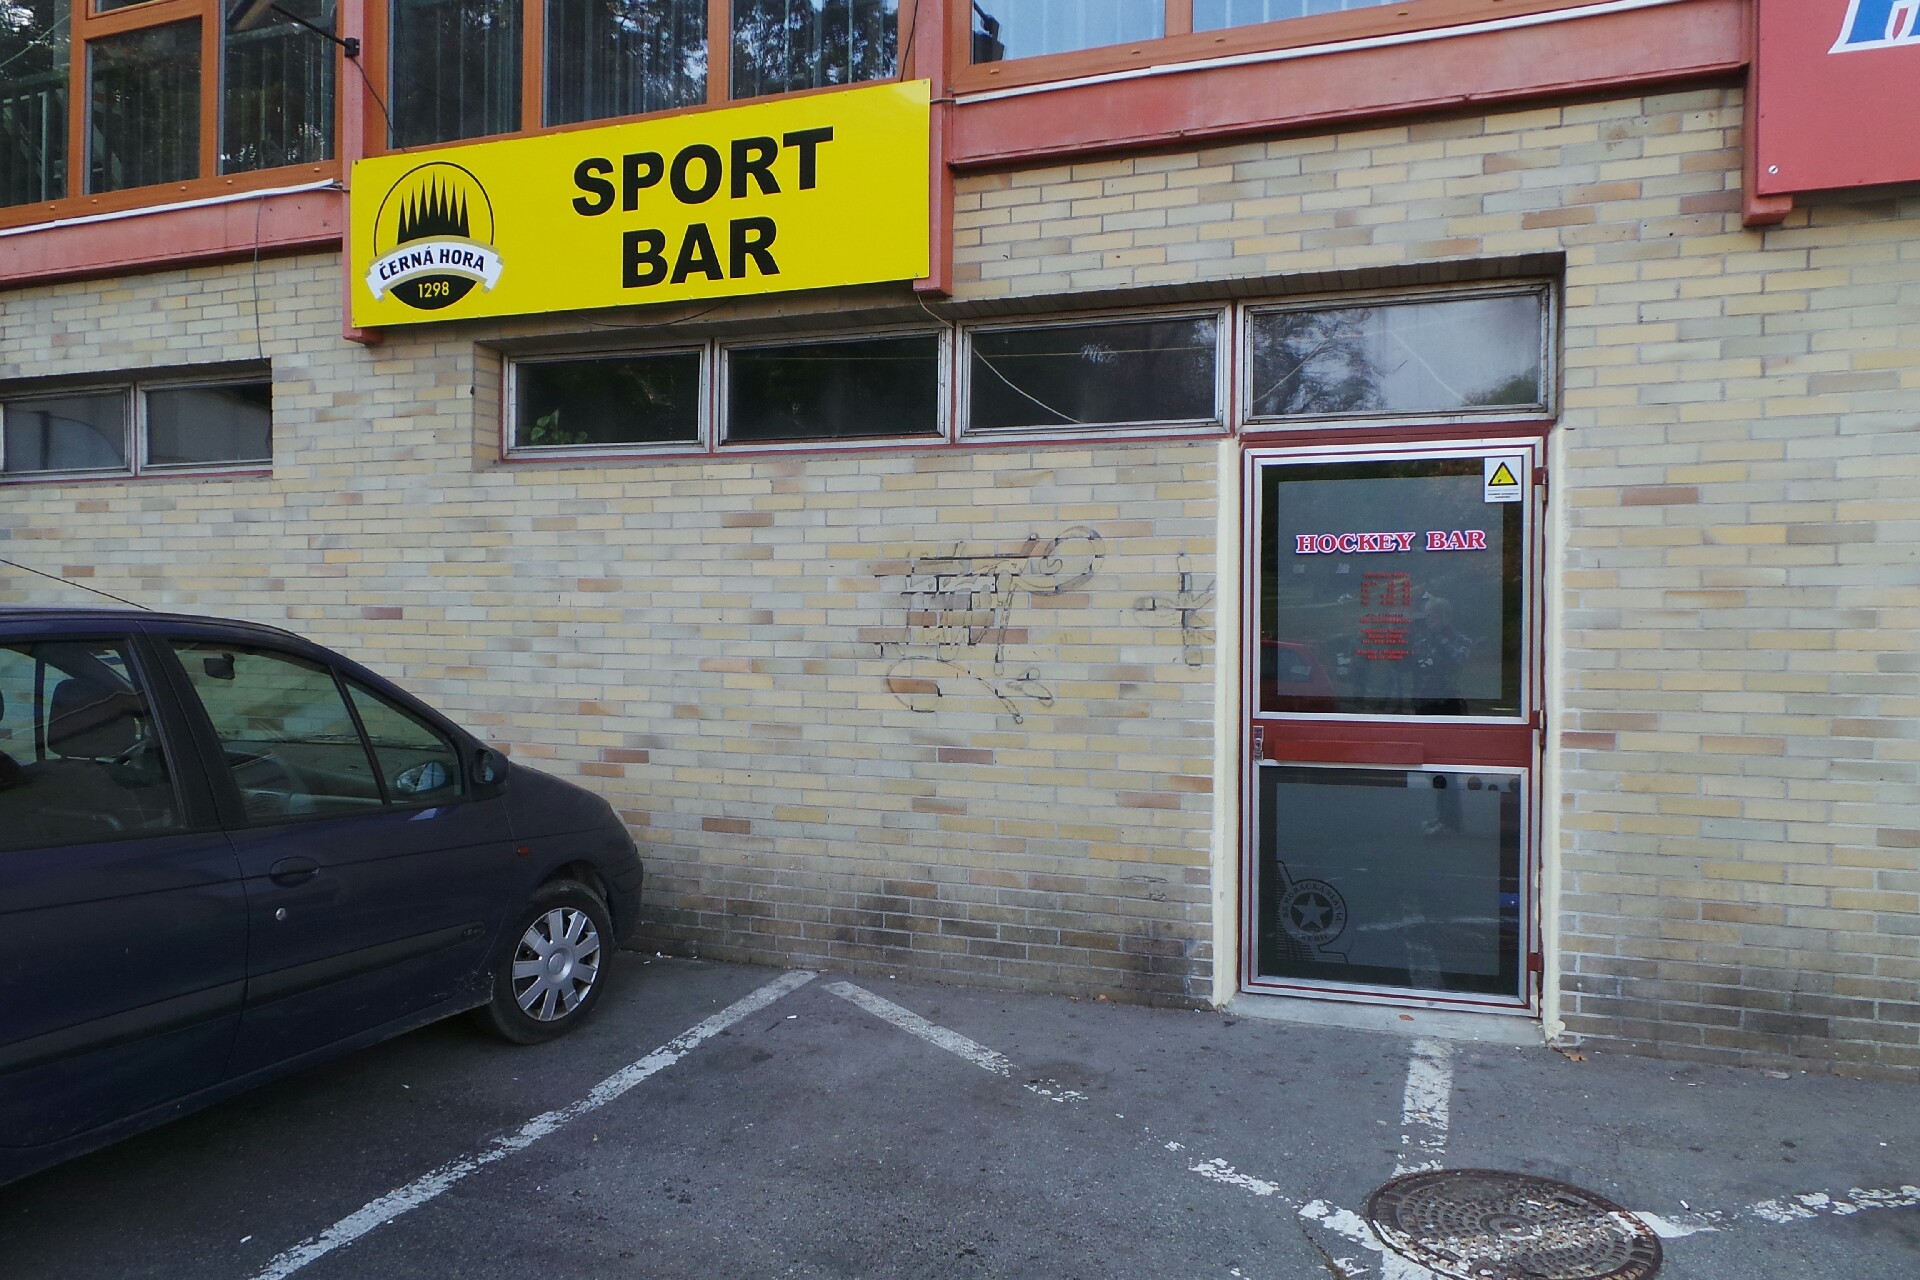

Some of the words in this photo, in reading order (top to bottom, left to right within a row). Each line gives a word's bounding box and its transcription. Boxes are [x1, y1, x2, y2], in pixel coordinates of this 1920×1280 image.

[571, 125, 834, 217] SPORT
[379, 246, 434, 281] ČERNÁ
[439, 248, 485, 272] HORA
[622, 216, 781, 290] BAR
[418, 281, 450, 298] 1298
[1296, 532, 1415, 553] HOCKEY
[1426, 530, 1487, 551] BAR
